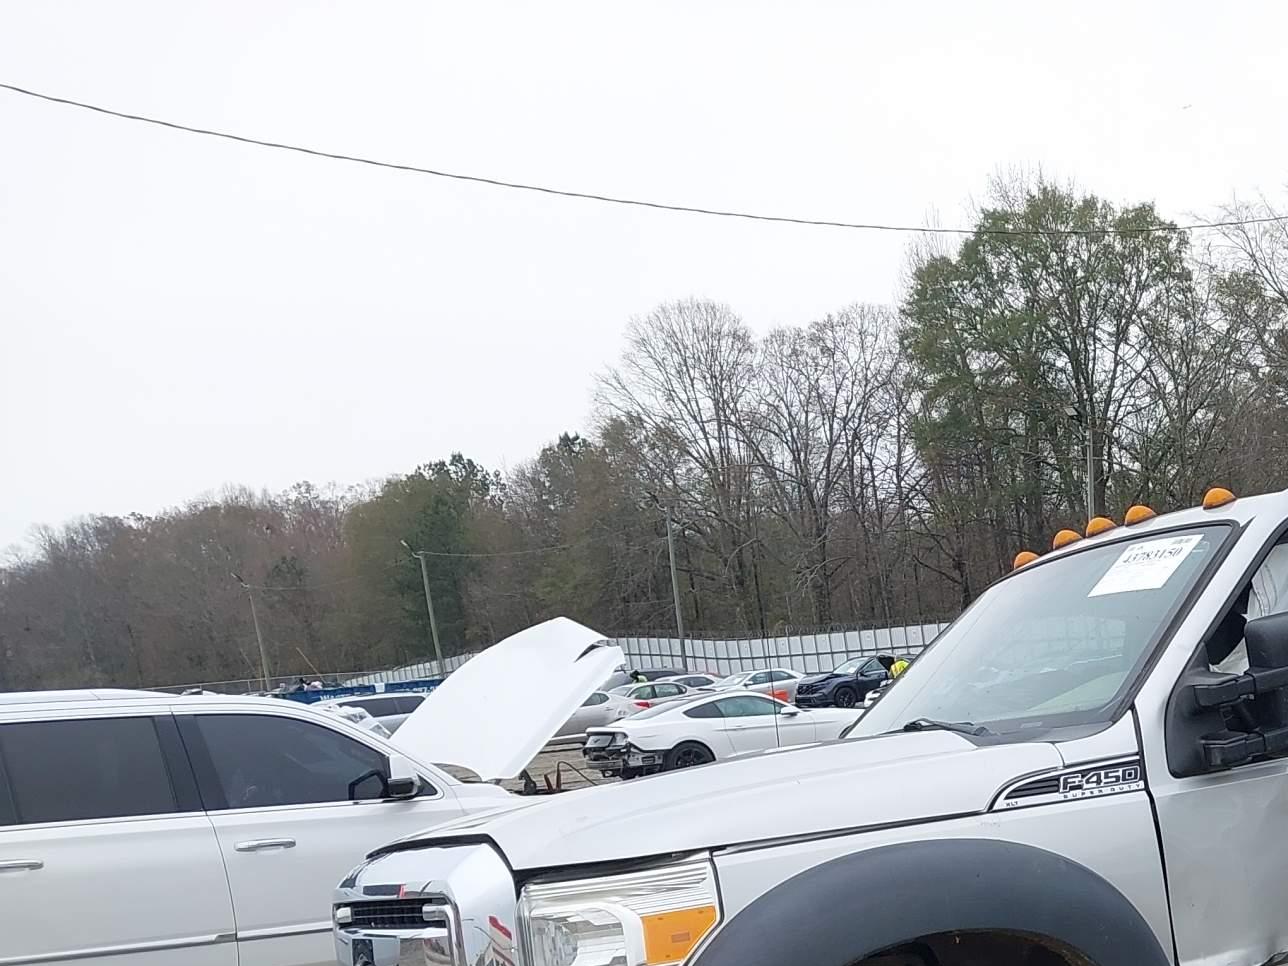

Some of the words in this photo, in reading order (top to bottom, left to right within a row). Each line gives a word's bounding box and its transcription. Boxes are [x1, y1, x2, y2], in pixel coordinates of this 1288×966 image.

[1060, 766, 1140, 793] F-450
[1063, 787, 1104, 799] SUPER
[1111, 783, 1141, 794] DUTY
